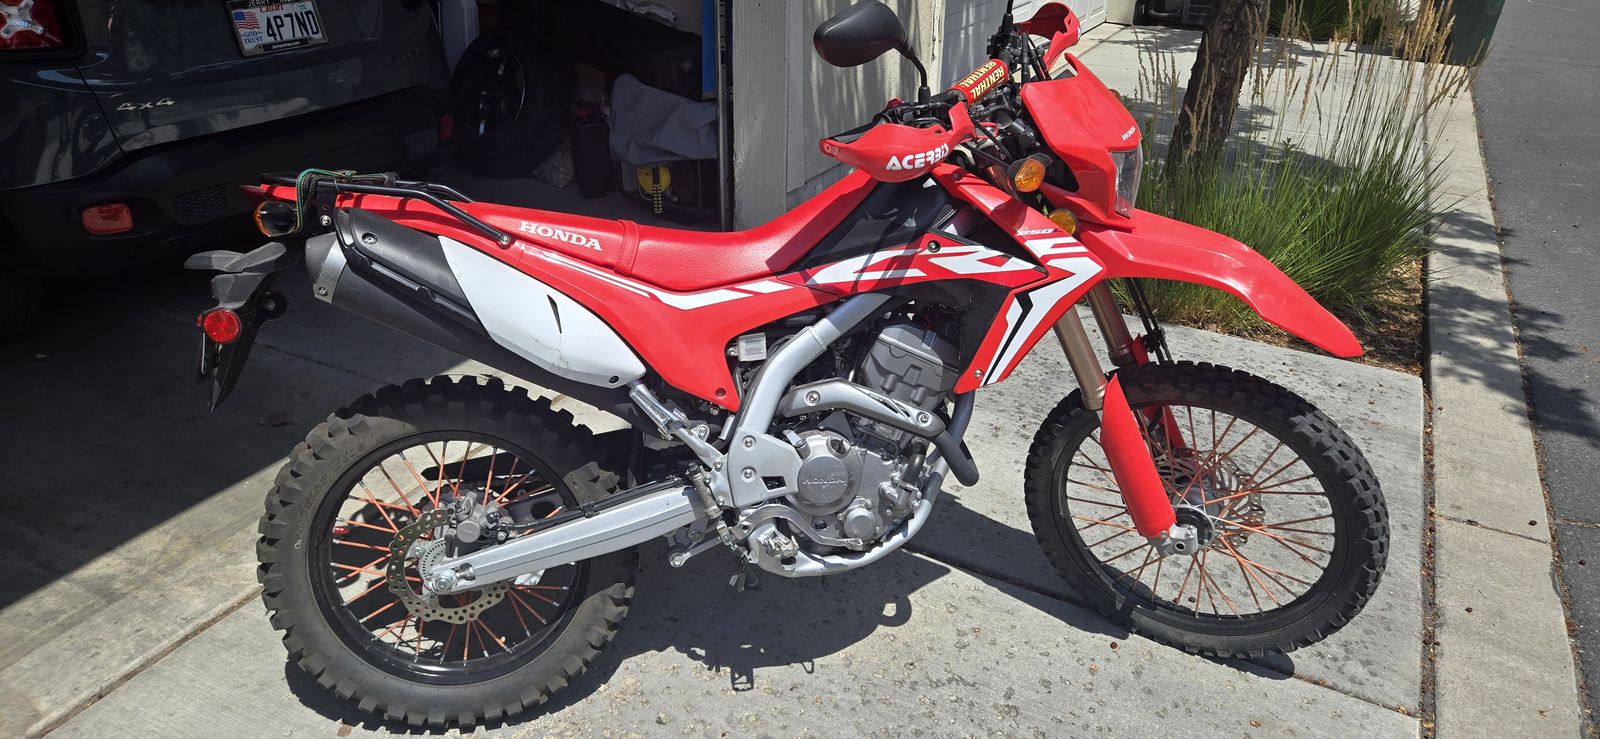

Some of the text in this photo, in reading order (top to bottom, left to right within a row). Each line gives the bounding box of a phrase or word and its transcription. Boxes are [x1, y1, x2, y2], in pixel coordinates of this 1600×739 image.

[243, 36, 264, 45] TRUST
[266, 11, 319, 41] 4P7ND
[959, 61, 997, 88] RENTHAL
[970, 66, 1005, 99] RENTHAL
[885, 142, 950, 171] ACERBIS
[519, 220, 603, 251] HONDA
